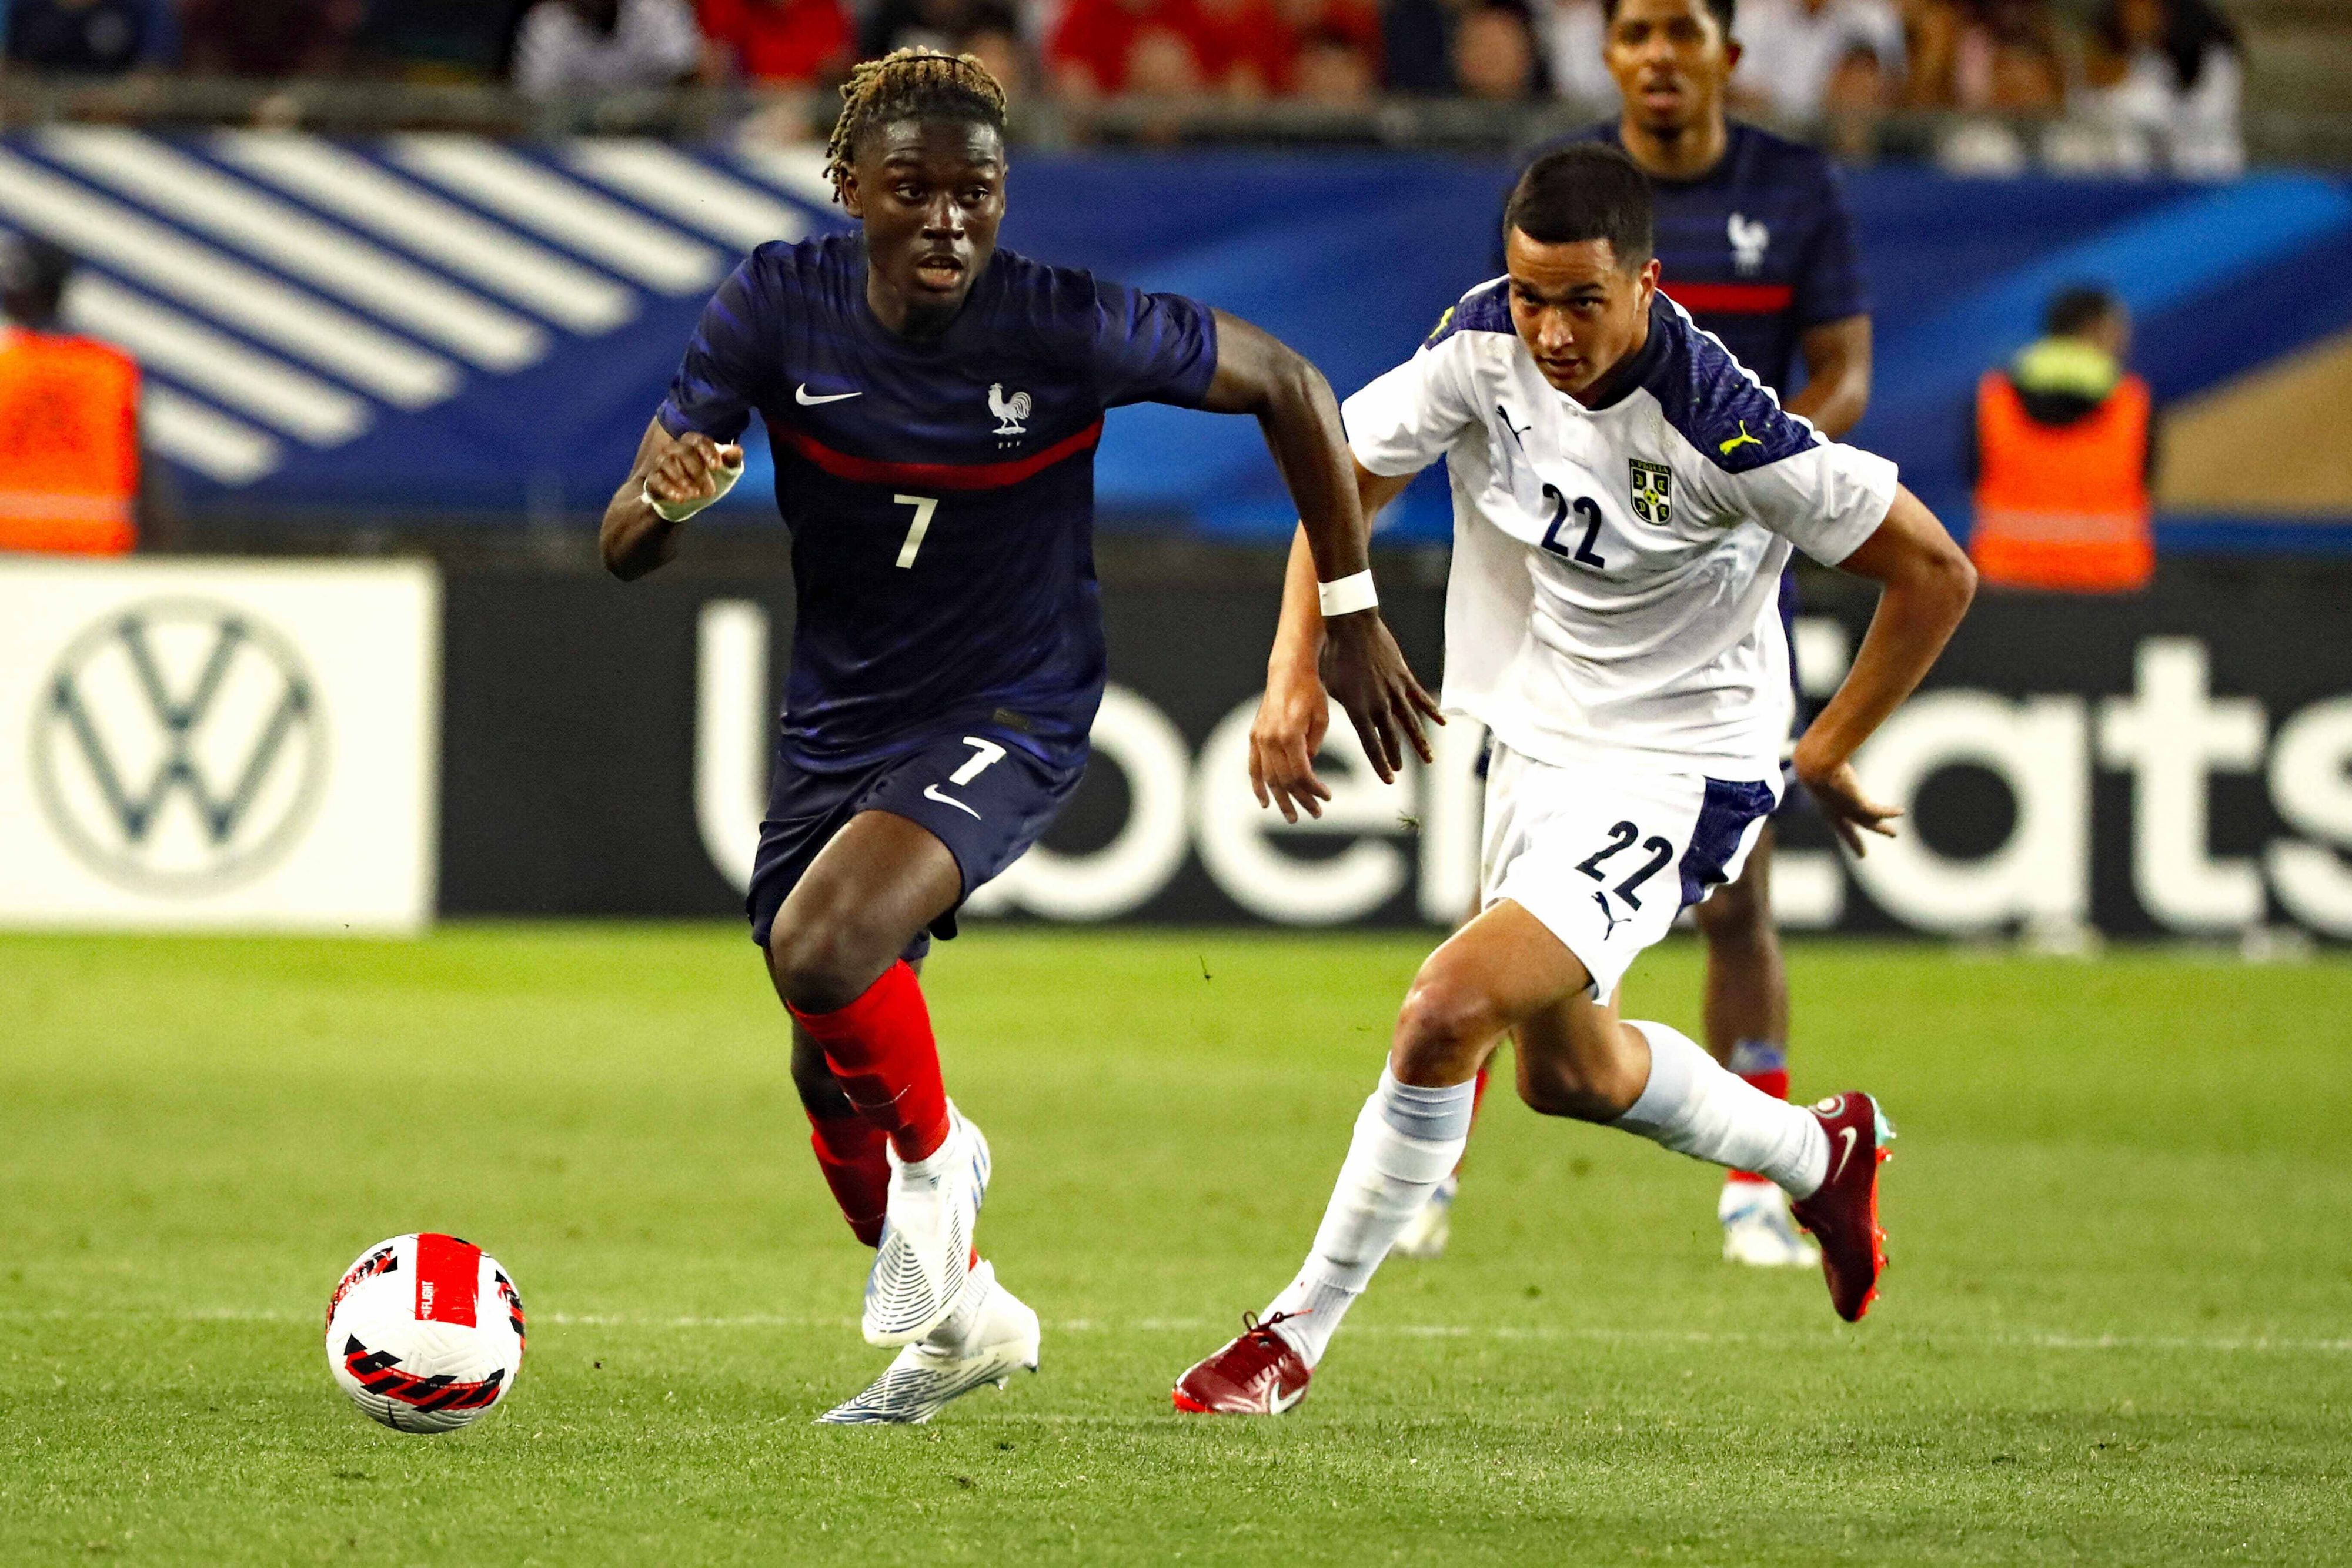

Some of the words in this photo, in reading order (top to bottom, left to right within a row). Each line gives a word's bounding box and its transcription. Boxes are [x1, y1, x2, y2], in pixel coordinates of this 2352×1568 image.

[894, 494, 938, 569] 7
[1541, 483, 1604, 568] 22
[948, 736, 1007, 787] 7
[1575, 821, 1673, 911] 22
